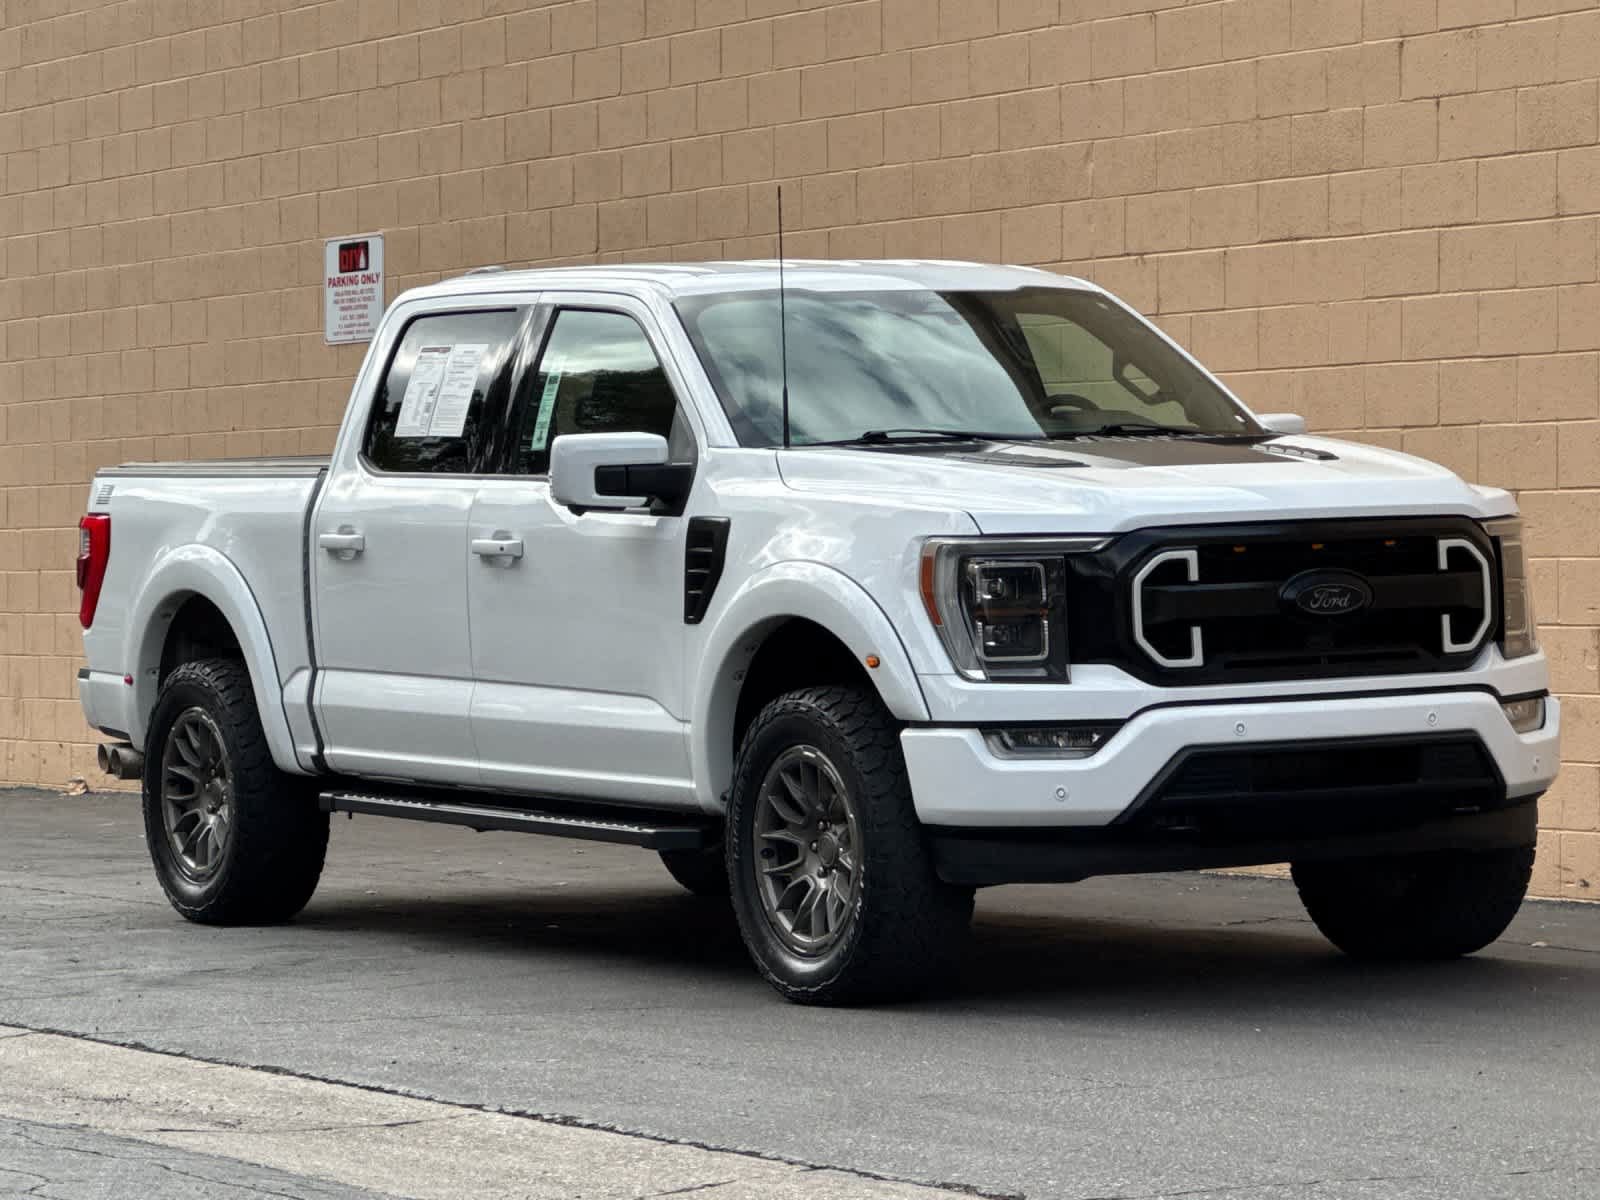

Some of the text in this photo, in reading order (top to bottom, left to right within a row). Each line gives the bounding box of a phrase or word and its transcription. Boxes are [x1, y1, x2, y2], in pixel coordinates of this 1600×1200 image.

[327, 272, 380, 288] PARKING ONLY
[1310, 588, 1351, 608] Ford
